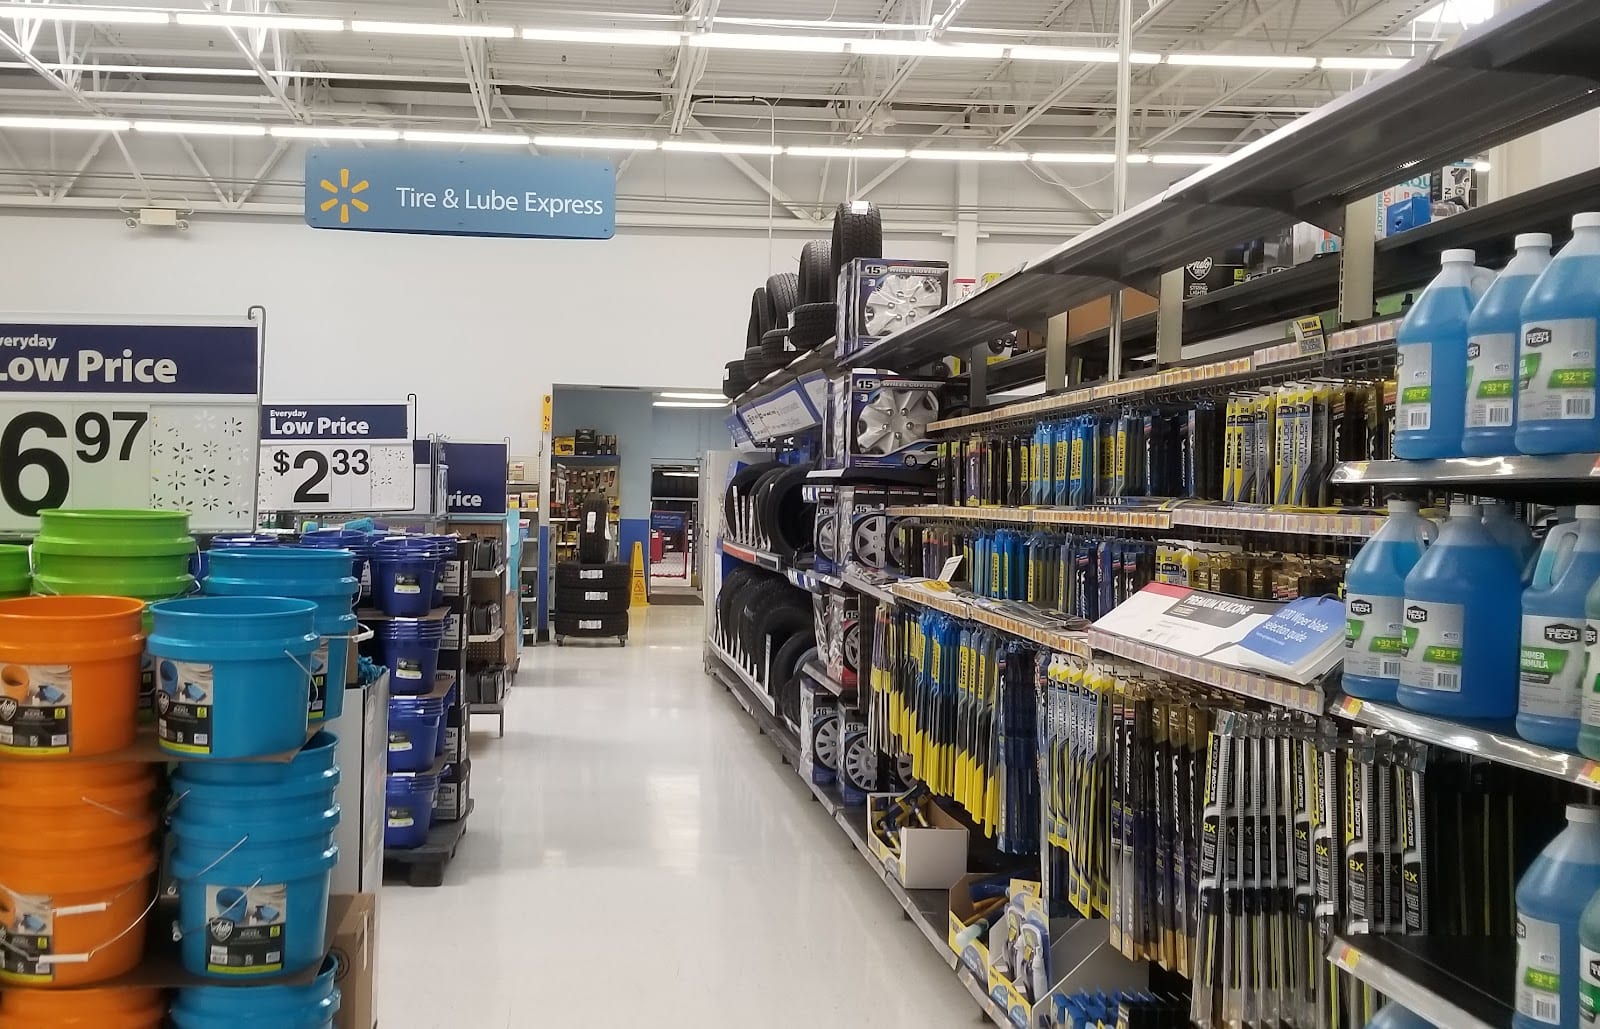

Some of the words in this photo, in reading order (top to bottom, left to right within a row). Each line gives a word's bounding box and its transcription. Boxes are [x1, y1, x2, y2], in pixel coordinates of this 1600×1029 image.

[396, 187, 436, 208] Tire
[442, 188, 459, 209] &
[466, 189, 518, 211] Lube
[525, 192, 603, 218] Express
[866, 266, 881, 275] 15
[1526, 336, 1550, 344] TECH
[78, 349, 178, 383] Price
[858, 380, 874, 389] 15
[270, 409, 307, 418] Everyday
[270, 417, 314, 435] Low
[317, 416, 370, 435] Price
[0, 411, 70, 518] 6
[74, 411, 148, 464] 97
[856, 504, 867, 513] 15
[1183, 594, 1214, 609] PREMIUM
[1215, 600, 1255, 616] SILICONE
[1291, 611, 1312, 627] Wiper
[1308, 617, 1329, 633] blade
[1262, 620, 1290, 636] selection
[1284, 630, 1308, 643] guide
[1546, 632, 1578, 640] TECH
[1203, 822, 1217, 834] 2X
[1315, 843, 1328, 857] 2X
[1349, 858, 1365, 873] 2X
[1404, 868, 1418, 883] 2X
